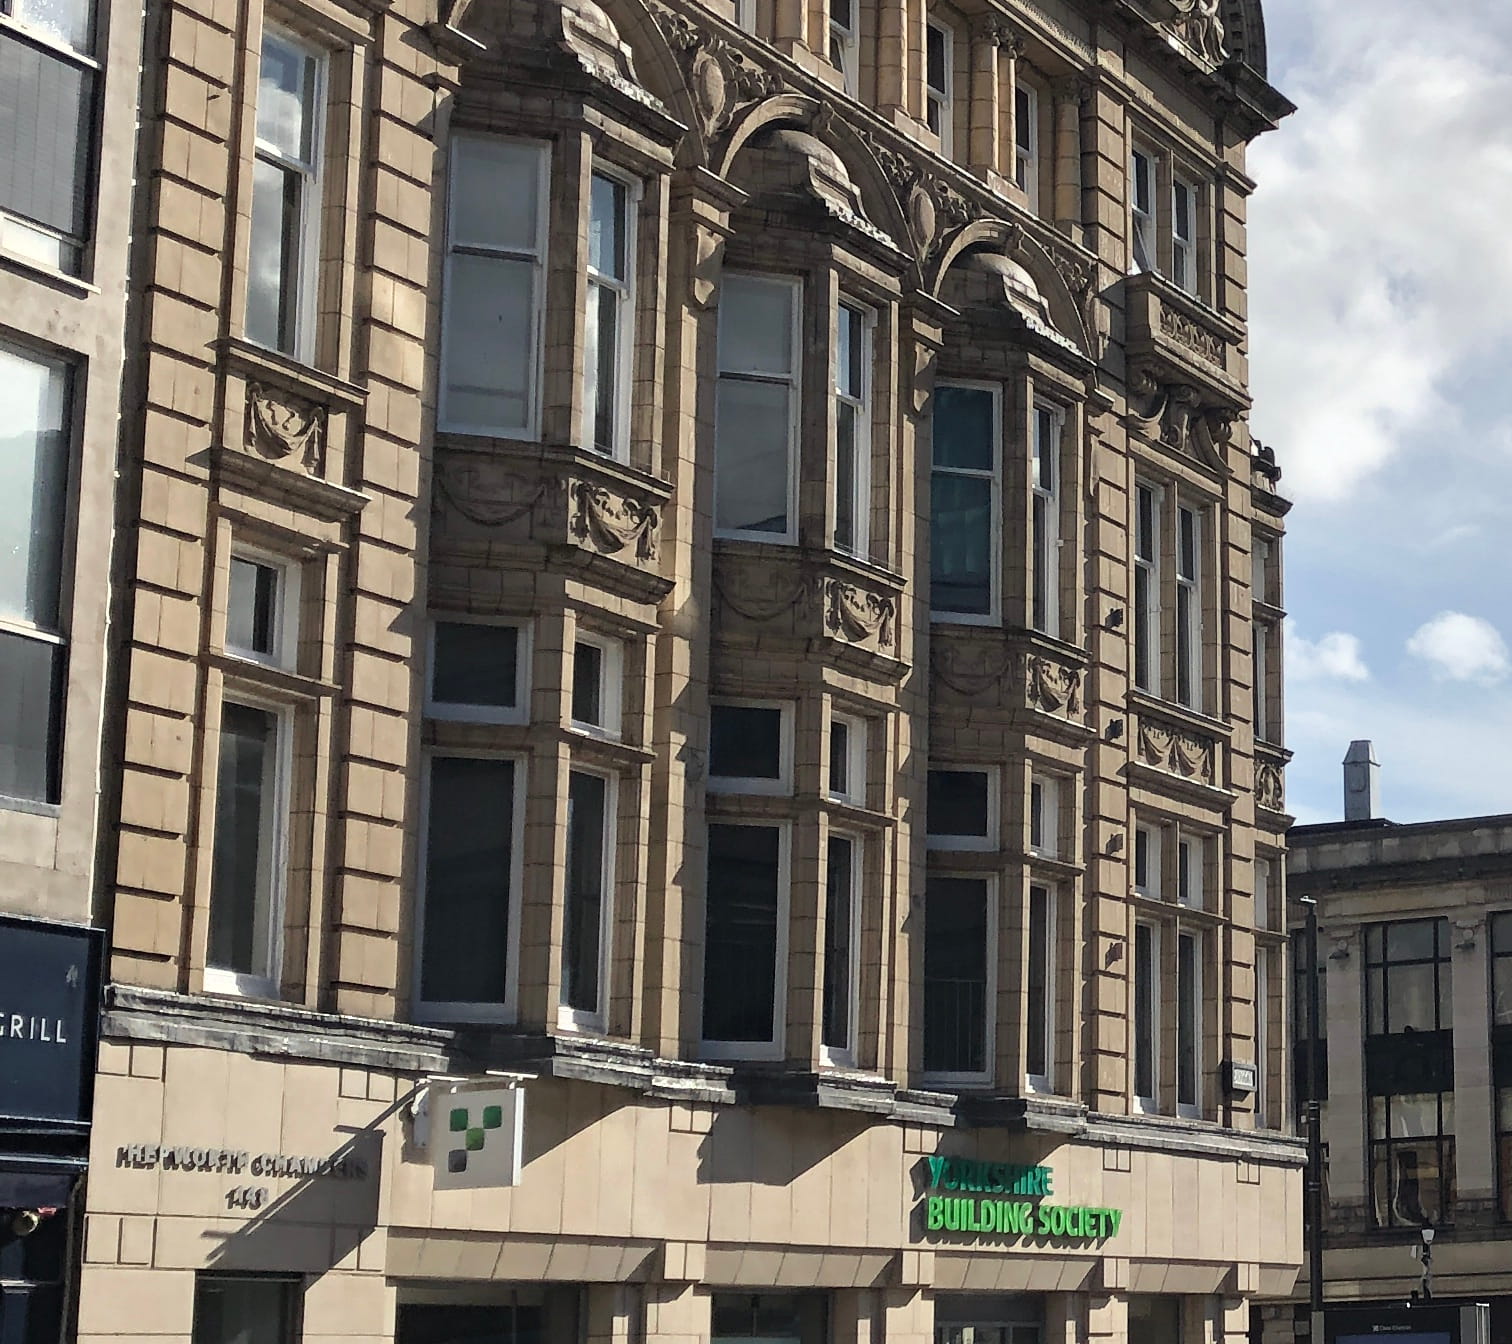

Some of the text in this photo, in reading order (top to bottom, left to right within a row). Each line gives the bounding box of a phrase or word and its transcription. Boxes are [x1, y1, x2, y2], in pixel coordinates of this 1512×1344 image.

[118, 1142, 249, 1173] HEPWORTH
[928, 1156, 1054, 1196] YORKSHIRE
[927, 1196, 1123, 1238] BUILDING SOCIETY
